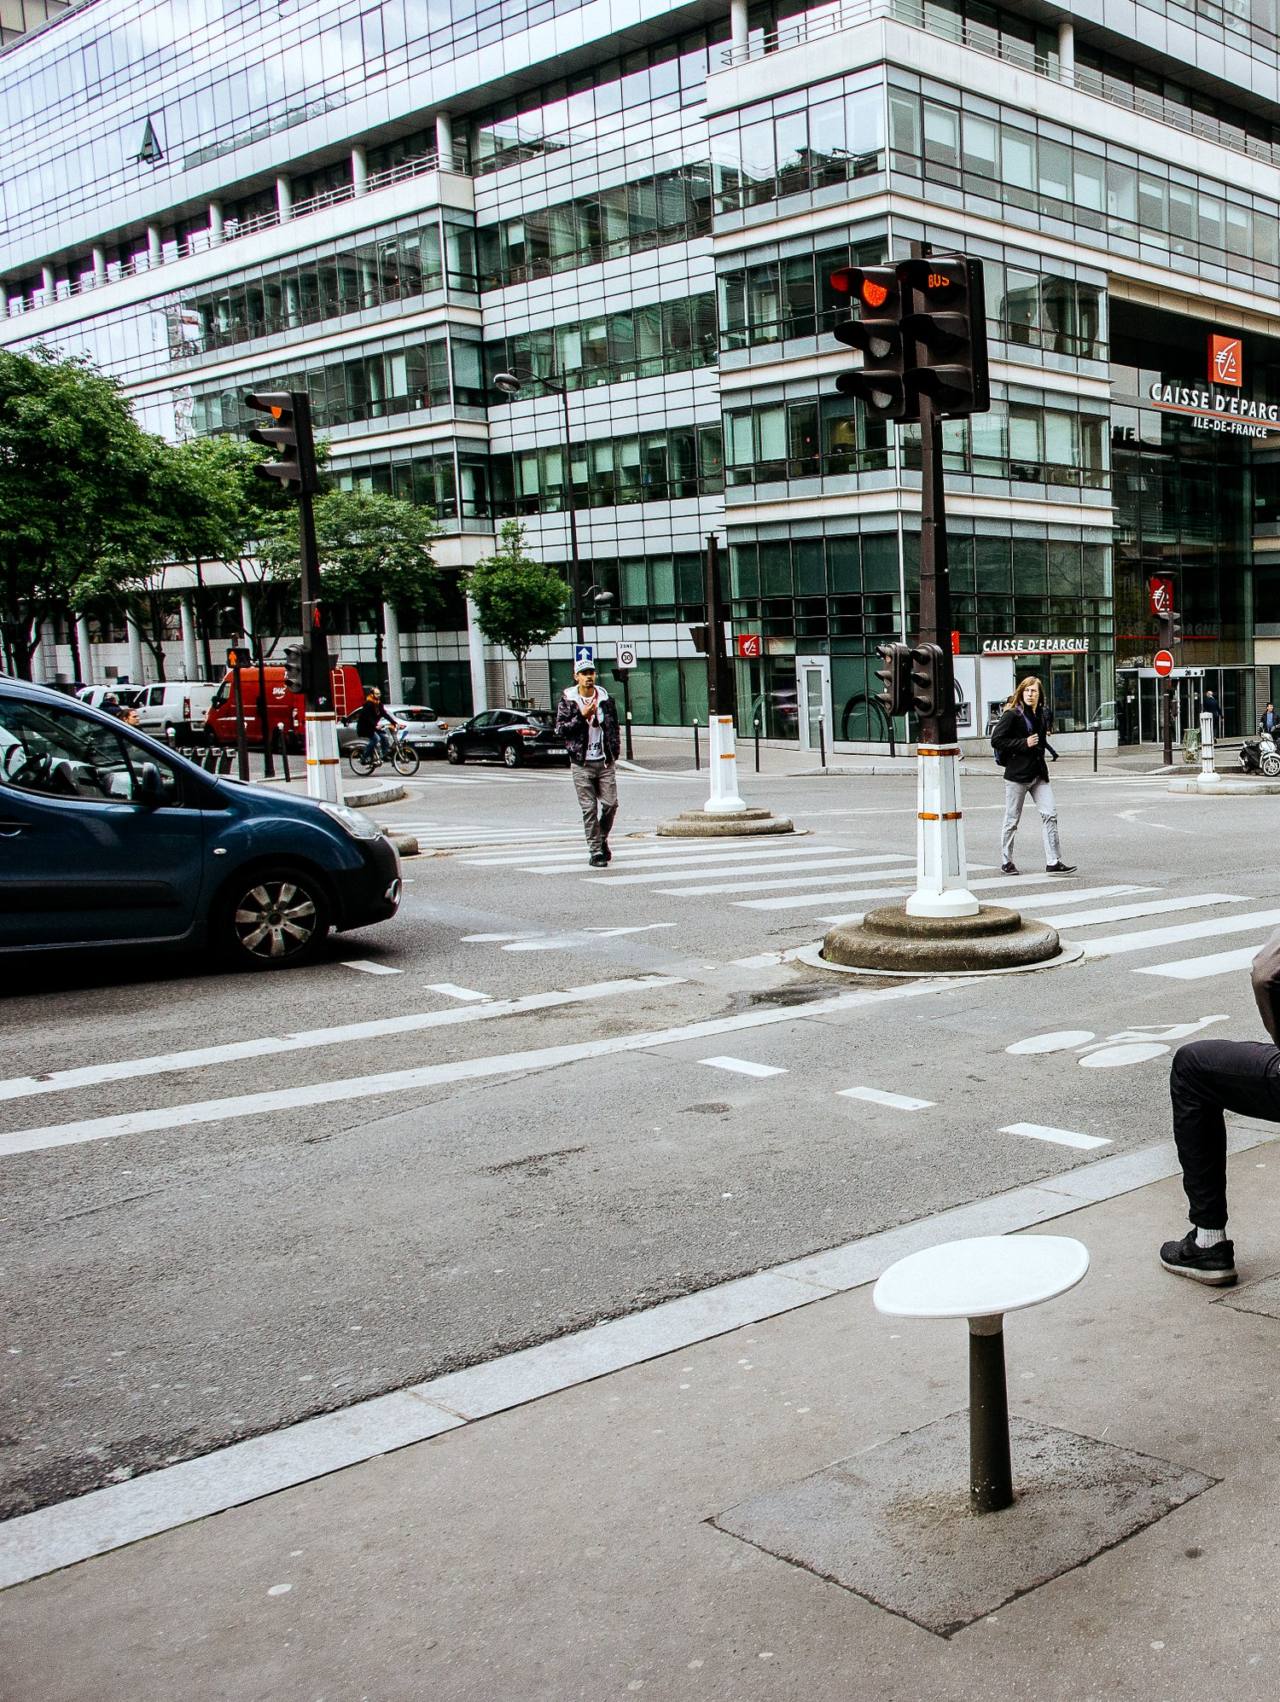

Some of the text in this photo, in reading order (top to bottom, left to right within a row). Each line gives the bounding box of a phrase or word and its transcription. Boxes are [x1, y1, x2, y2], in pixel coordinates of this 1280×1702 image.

[928, 274, 950, 288] BUS
[1151, 383, 1210, 408] CAISSE
[983, 639, 1089, 651] CAISSE D'EPARGNE
